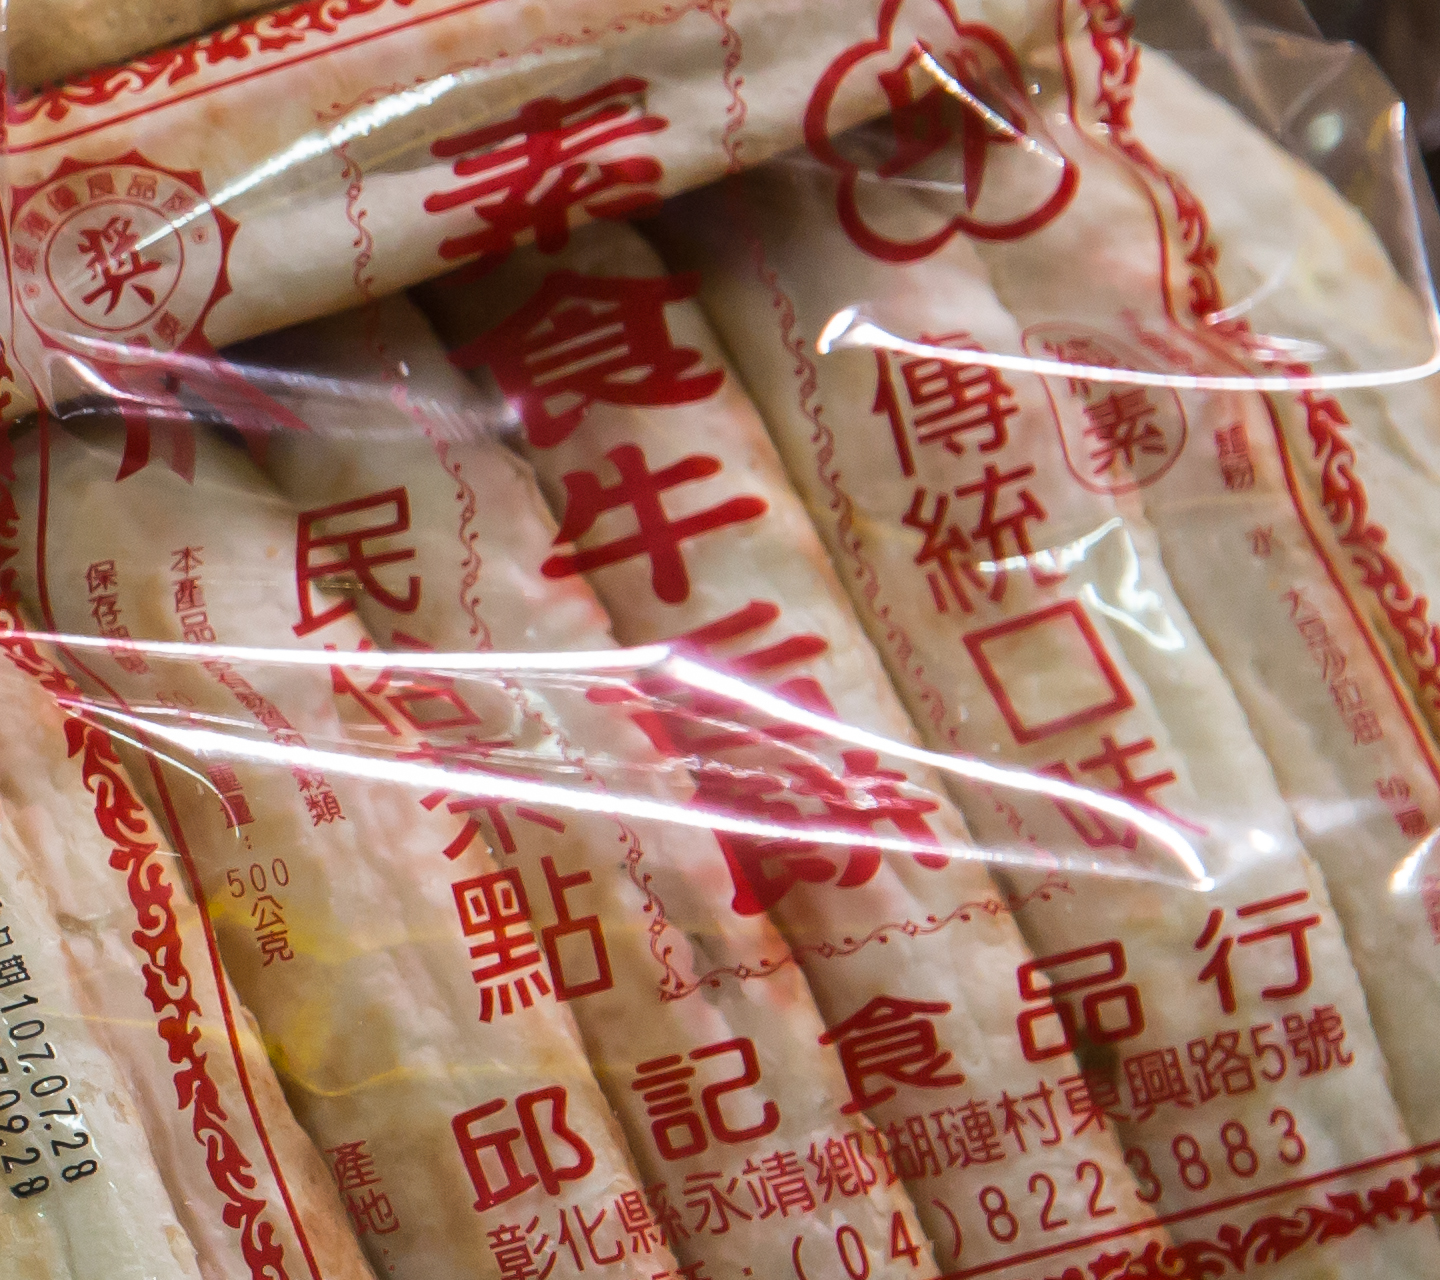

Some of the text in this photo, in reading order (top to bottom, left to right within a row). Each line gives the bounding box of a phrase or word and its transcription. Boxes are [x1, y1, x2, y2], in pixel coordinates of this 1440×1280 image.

[451, 889, 1320, 1212] 邱記食品行
